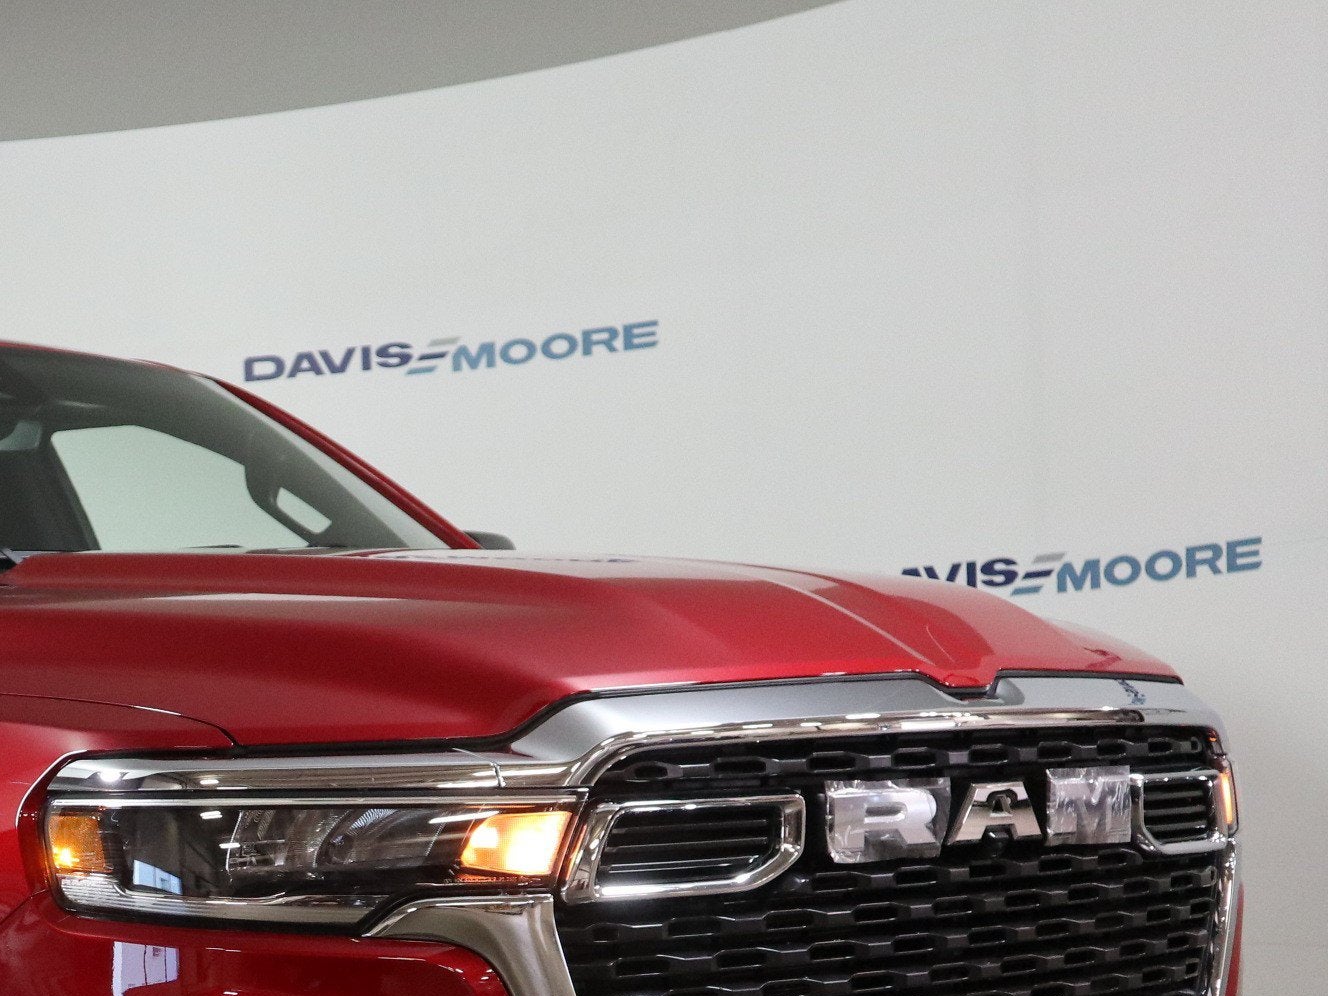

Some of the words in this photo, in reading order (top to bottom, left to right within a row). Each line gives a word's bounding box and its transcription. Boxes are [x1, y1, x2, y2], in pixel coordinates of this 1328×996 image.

[243, 342, 413, 382] DAVIS
[451, 319, 661, 373] MOORE
[1056, 536, 1263, 593] MOORE
[825, 770, 1132, 854] RAM
